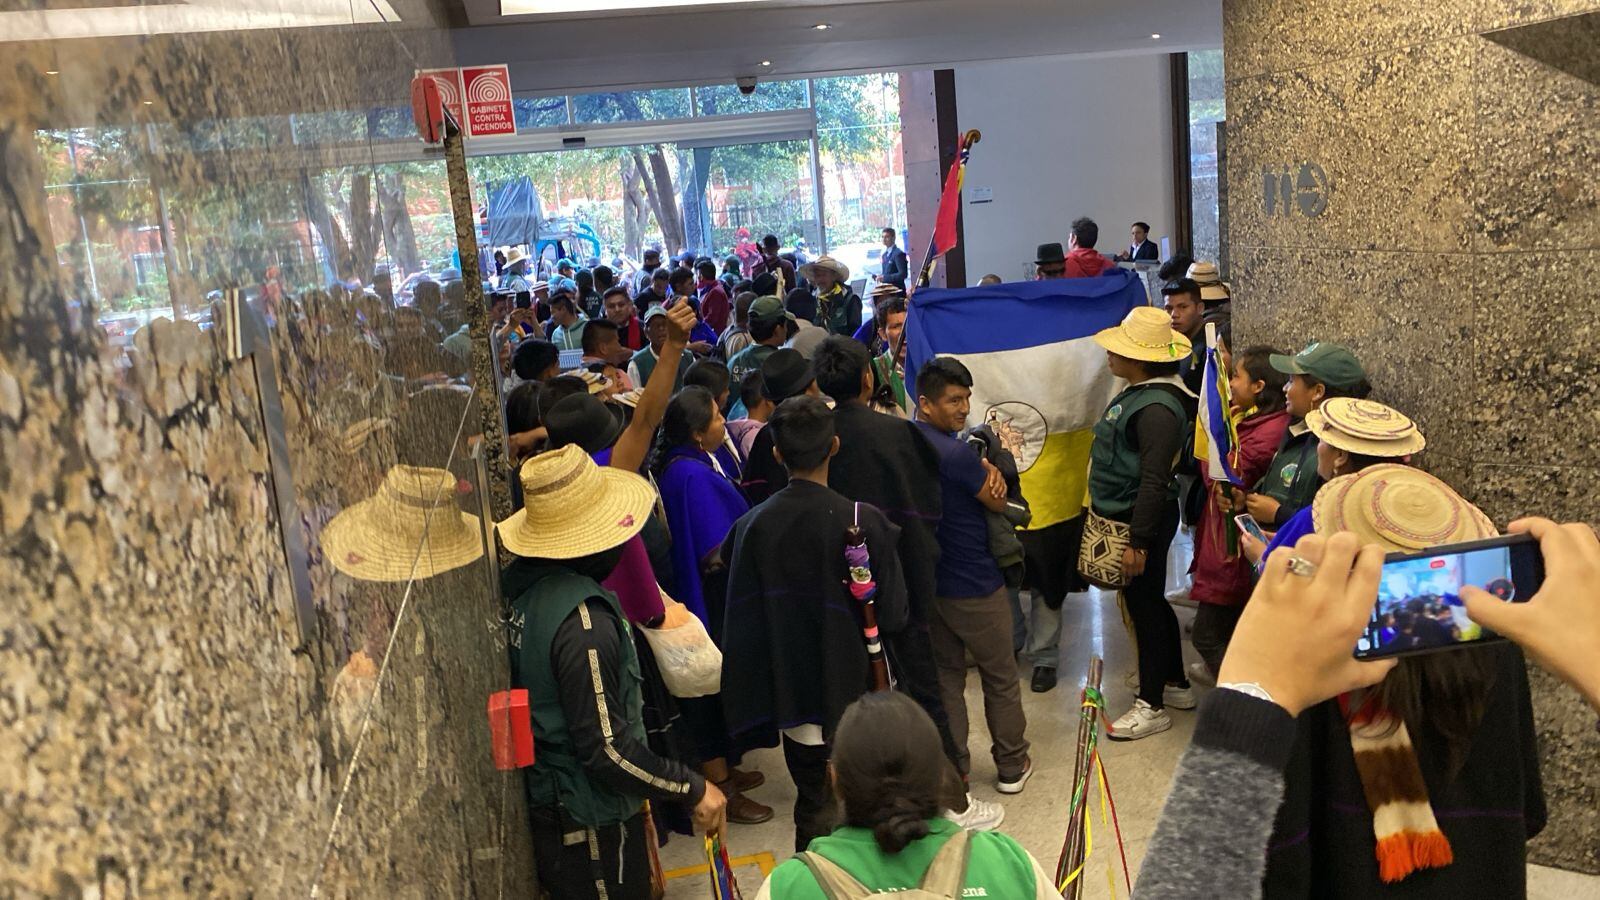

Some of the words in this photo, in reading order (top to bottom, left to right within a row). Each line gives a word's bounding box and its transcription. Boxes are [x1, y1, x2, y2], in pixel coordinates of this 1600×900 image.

[470, 104, 508, 114] GABINETE
[474, 113, 506, 123] CONTRA
[472, 121, 513, 131] INCENDIOS
